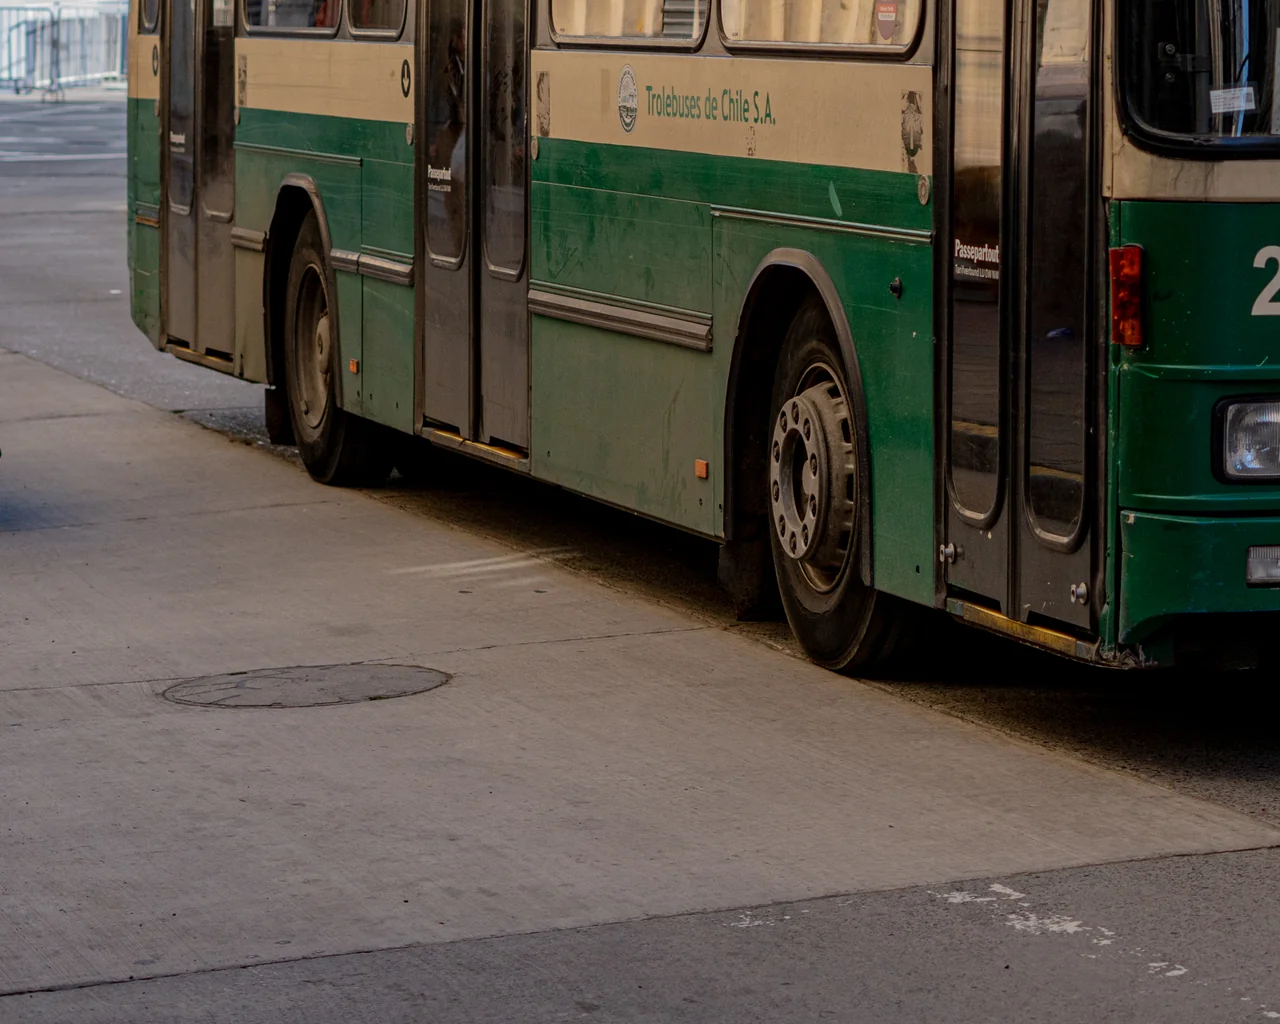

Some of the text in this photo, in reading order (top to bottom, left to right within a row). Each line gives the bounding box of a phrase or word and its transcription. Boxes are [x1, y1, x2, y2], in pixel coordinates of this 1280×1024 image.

[645, 85, 776, 125] Trolebuses de Chile S.A.
[954, 239, 999, 263] Passepartout
